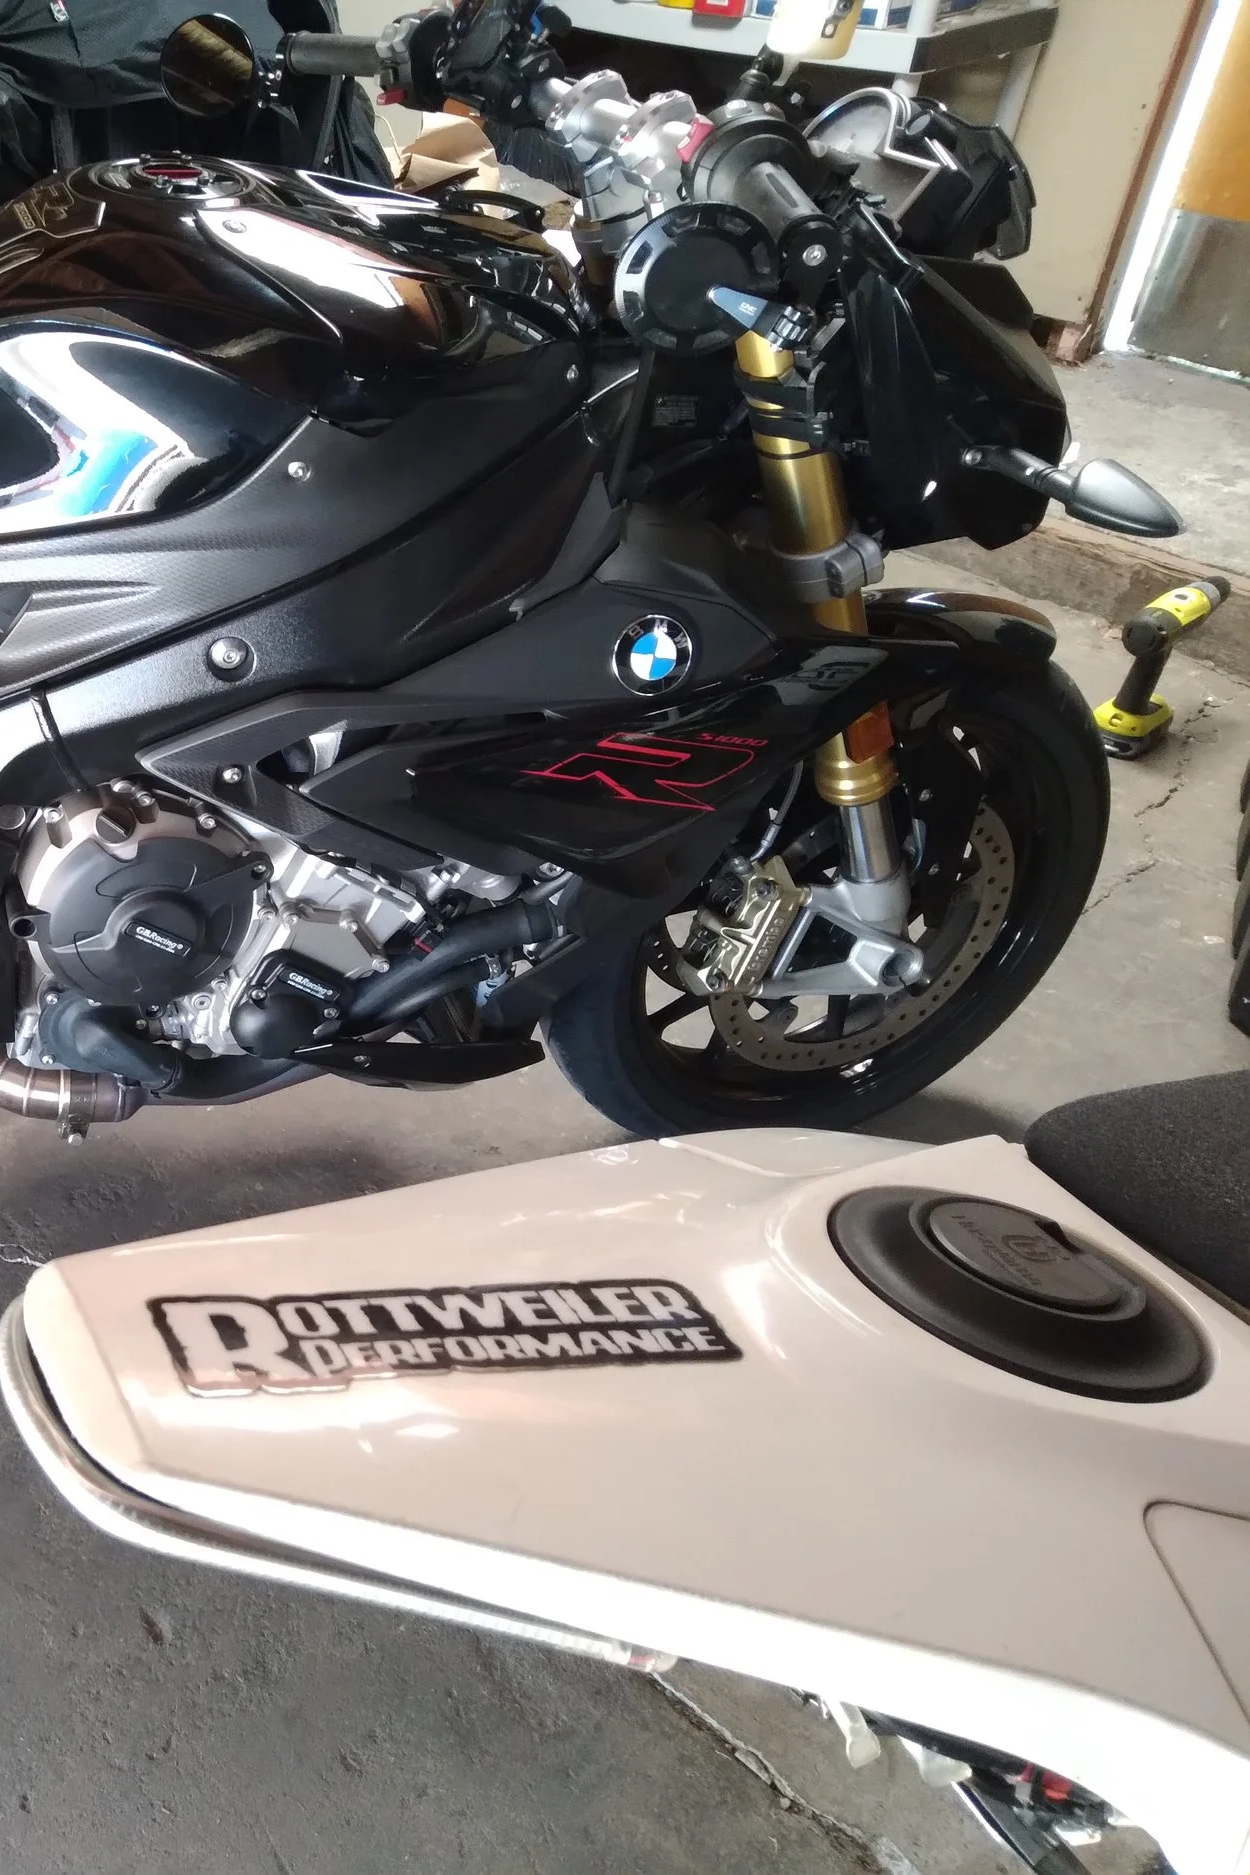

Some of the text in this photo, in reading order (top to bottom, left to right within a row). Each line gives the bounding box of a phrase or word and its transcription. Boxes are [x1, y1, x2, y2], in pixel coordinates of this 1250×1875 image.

[628, 619, 689, 649] BMW
[697, 731, 769, 747] S1000
[161, 1285, 701, 1382] ROTTWEILER
[300, 1326, 726, 1378] PERFORMANCE
